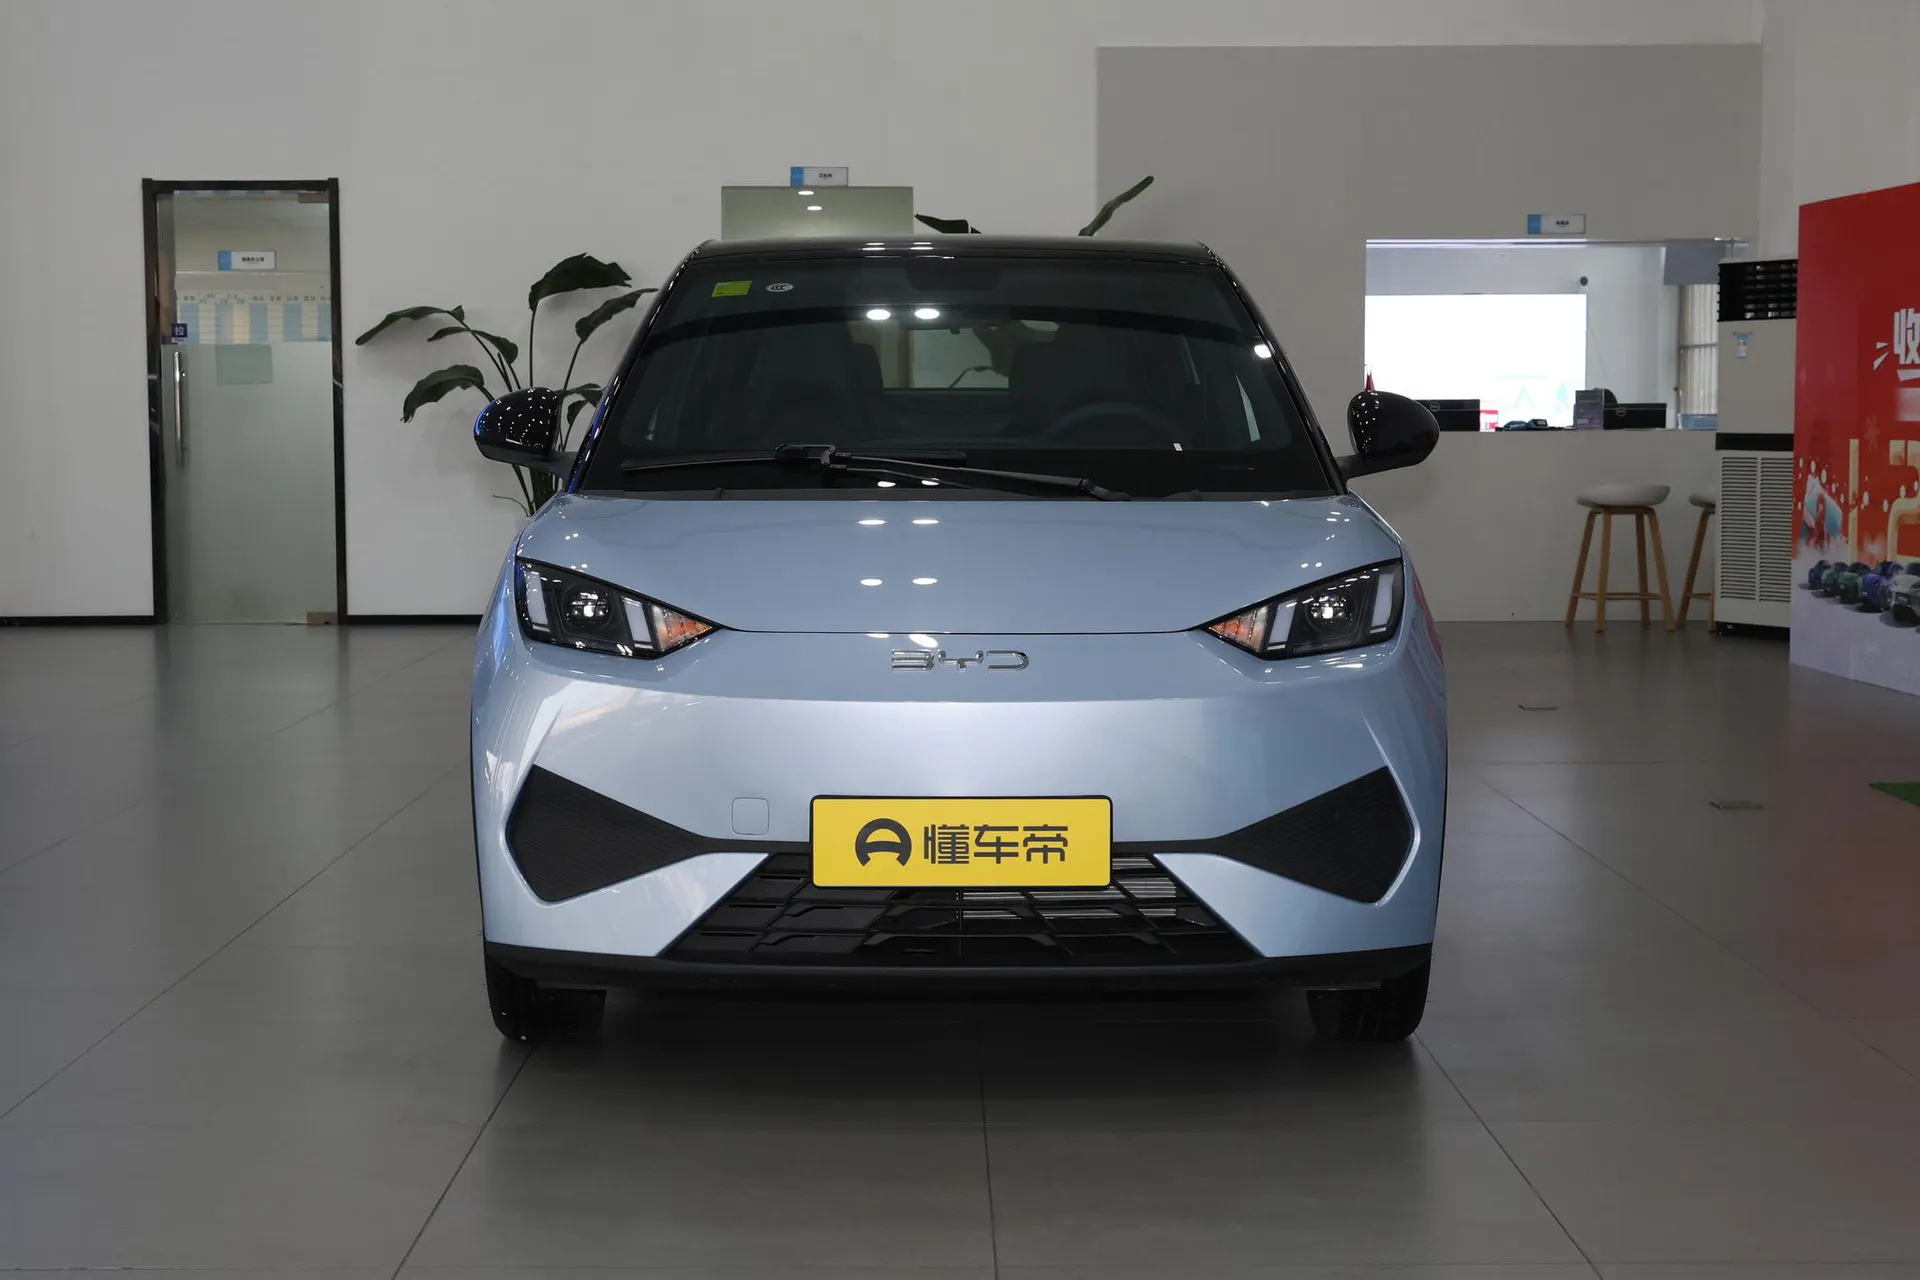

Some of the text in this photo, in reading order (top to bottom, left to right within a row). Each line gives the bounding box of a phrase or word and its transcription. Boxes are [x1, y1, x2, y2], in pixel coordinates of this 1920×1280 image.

[891, 649, 1029, 672] BYD
[924, 824, 1068, 864] 懂车帝
